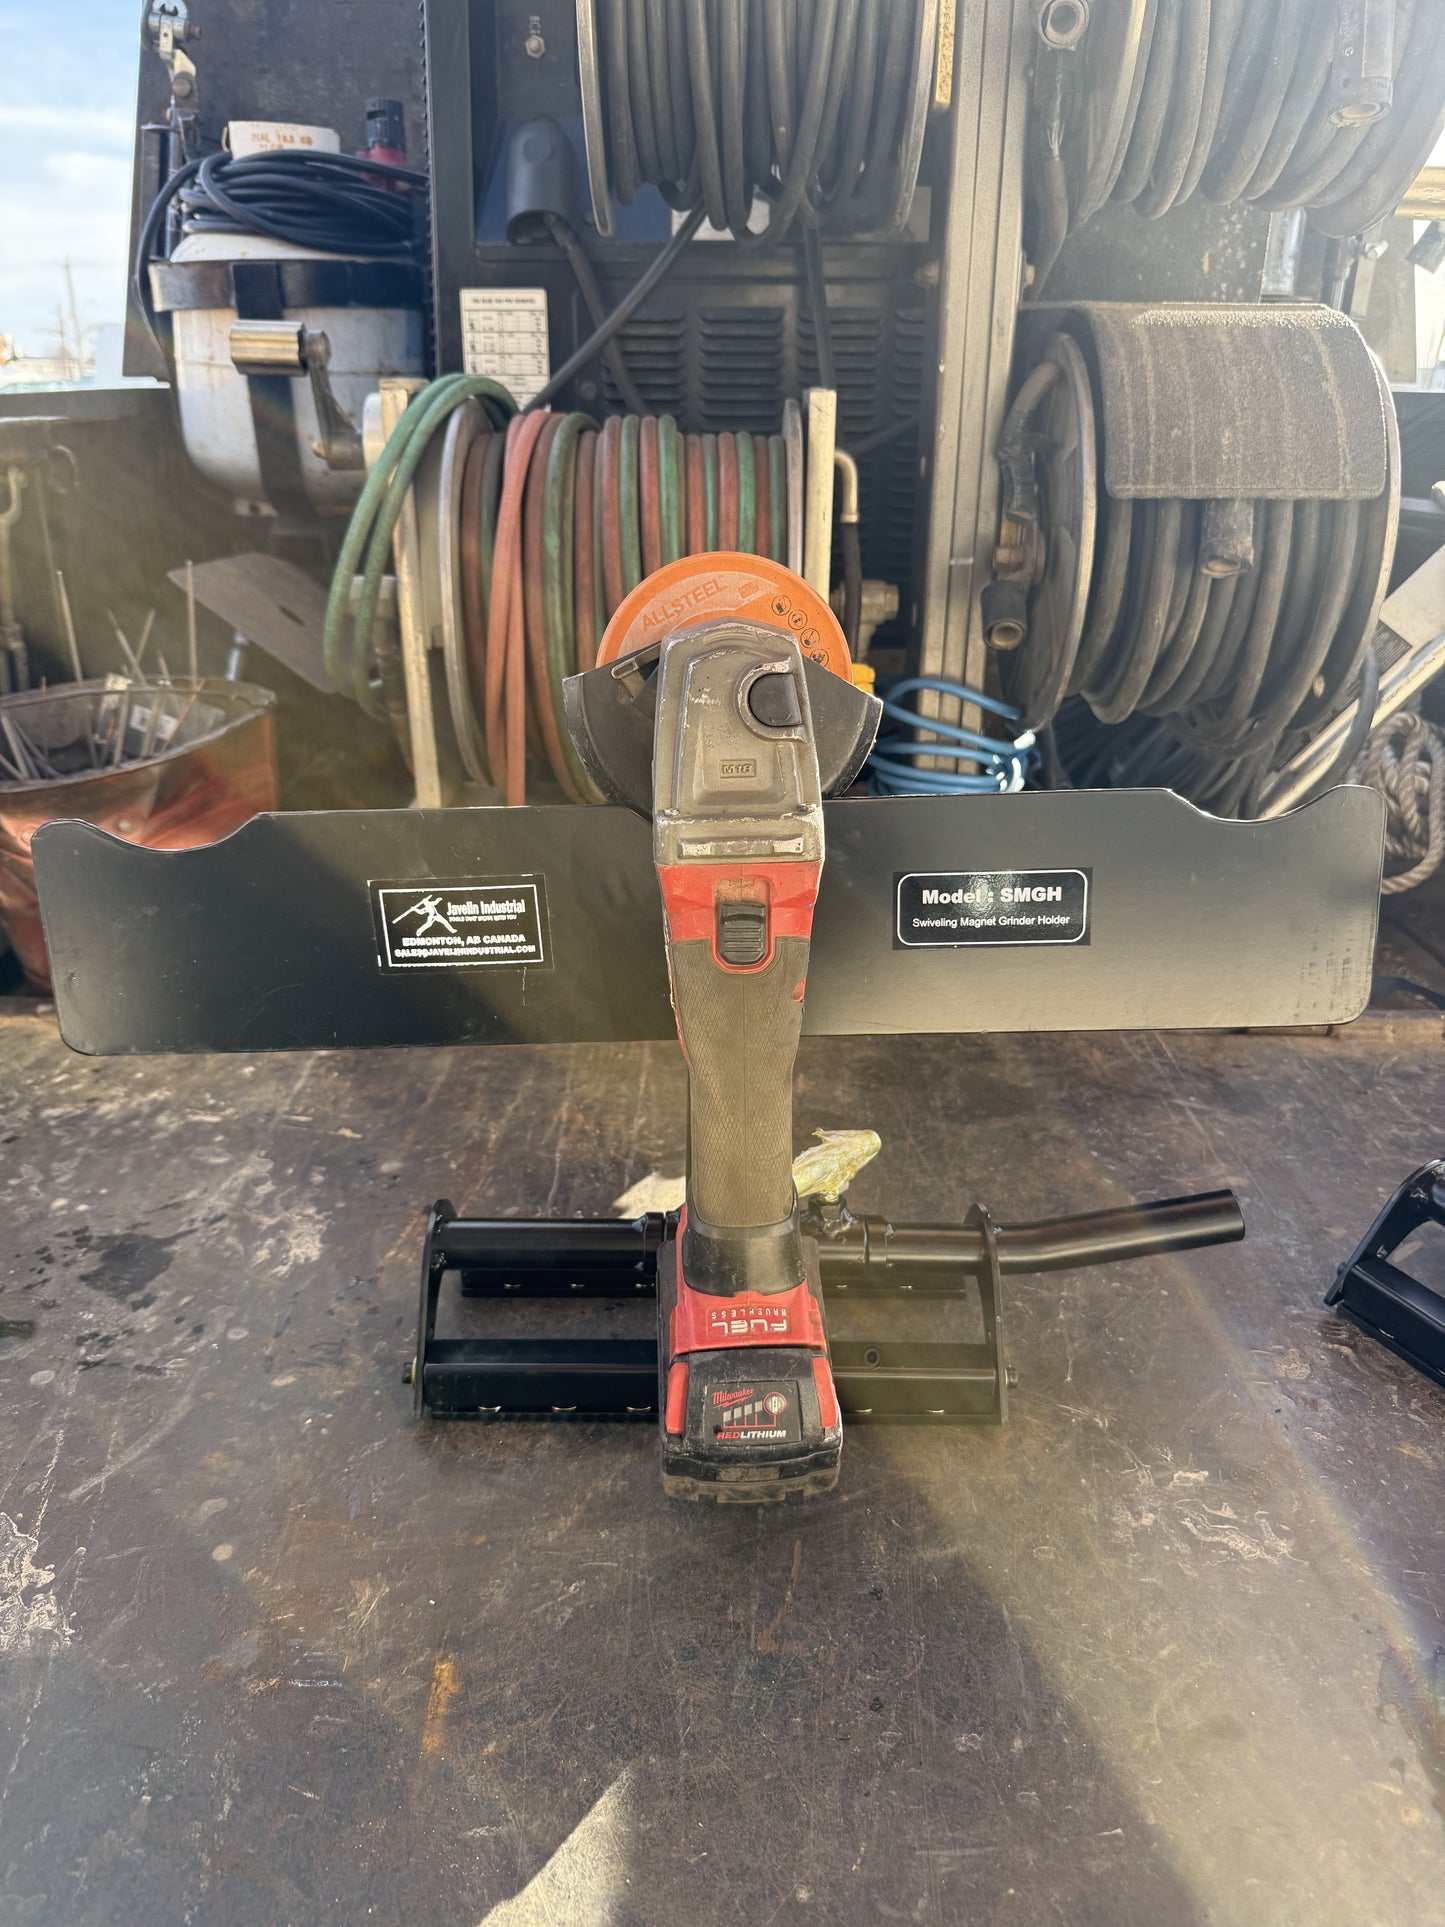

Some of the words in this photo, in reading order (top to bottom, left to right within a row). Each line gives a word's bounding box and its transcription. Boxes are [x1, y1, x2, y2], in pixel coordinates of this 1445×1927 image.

[641, 578, 727, 632] ALLSTEEL
[1000, 886, 1063, 903] SMGH
[447, 901, 479, 916] Javelin
[480, 899, 526, 914] Industrial
[912, 917, 957, 929] Swiveling
[960, 917, 996, 928] Magnet
[998, 916, 1035, 926] Grinder
[1038, 915, 1070, 926] Holder
[402, 937, 465, 947] EDMONTON,
[466, 935, 481, 945] AB
[482, 934, 526, 944] CANADA
[711, 1307, 787, 1319] BRUSHLESS
[711, 1319, 787, 1335] FUEL
[711, 1387, 754, 1405] Milwaukee
